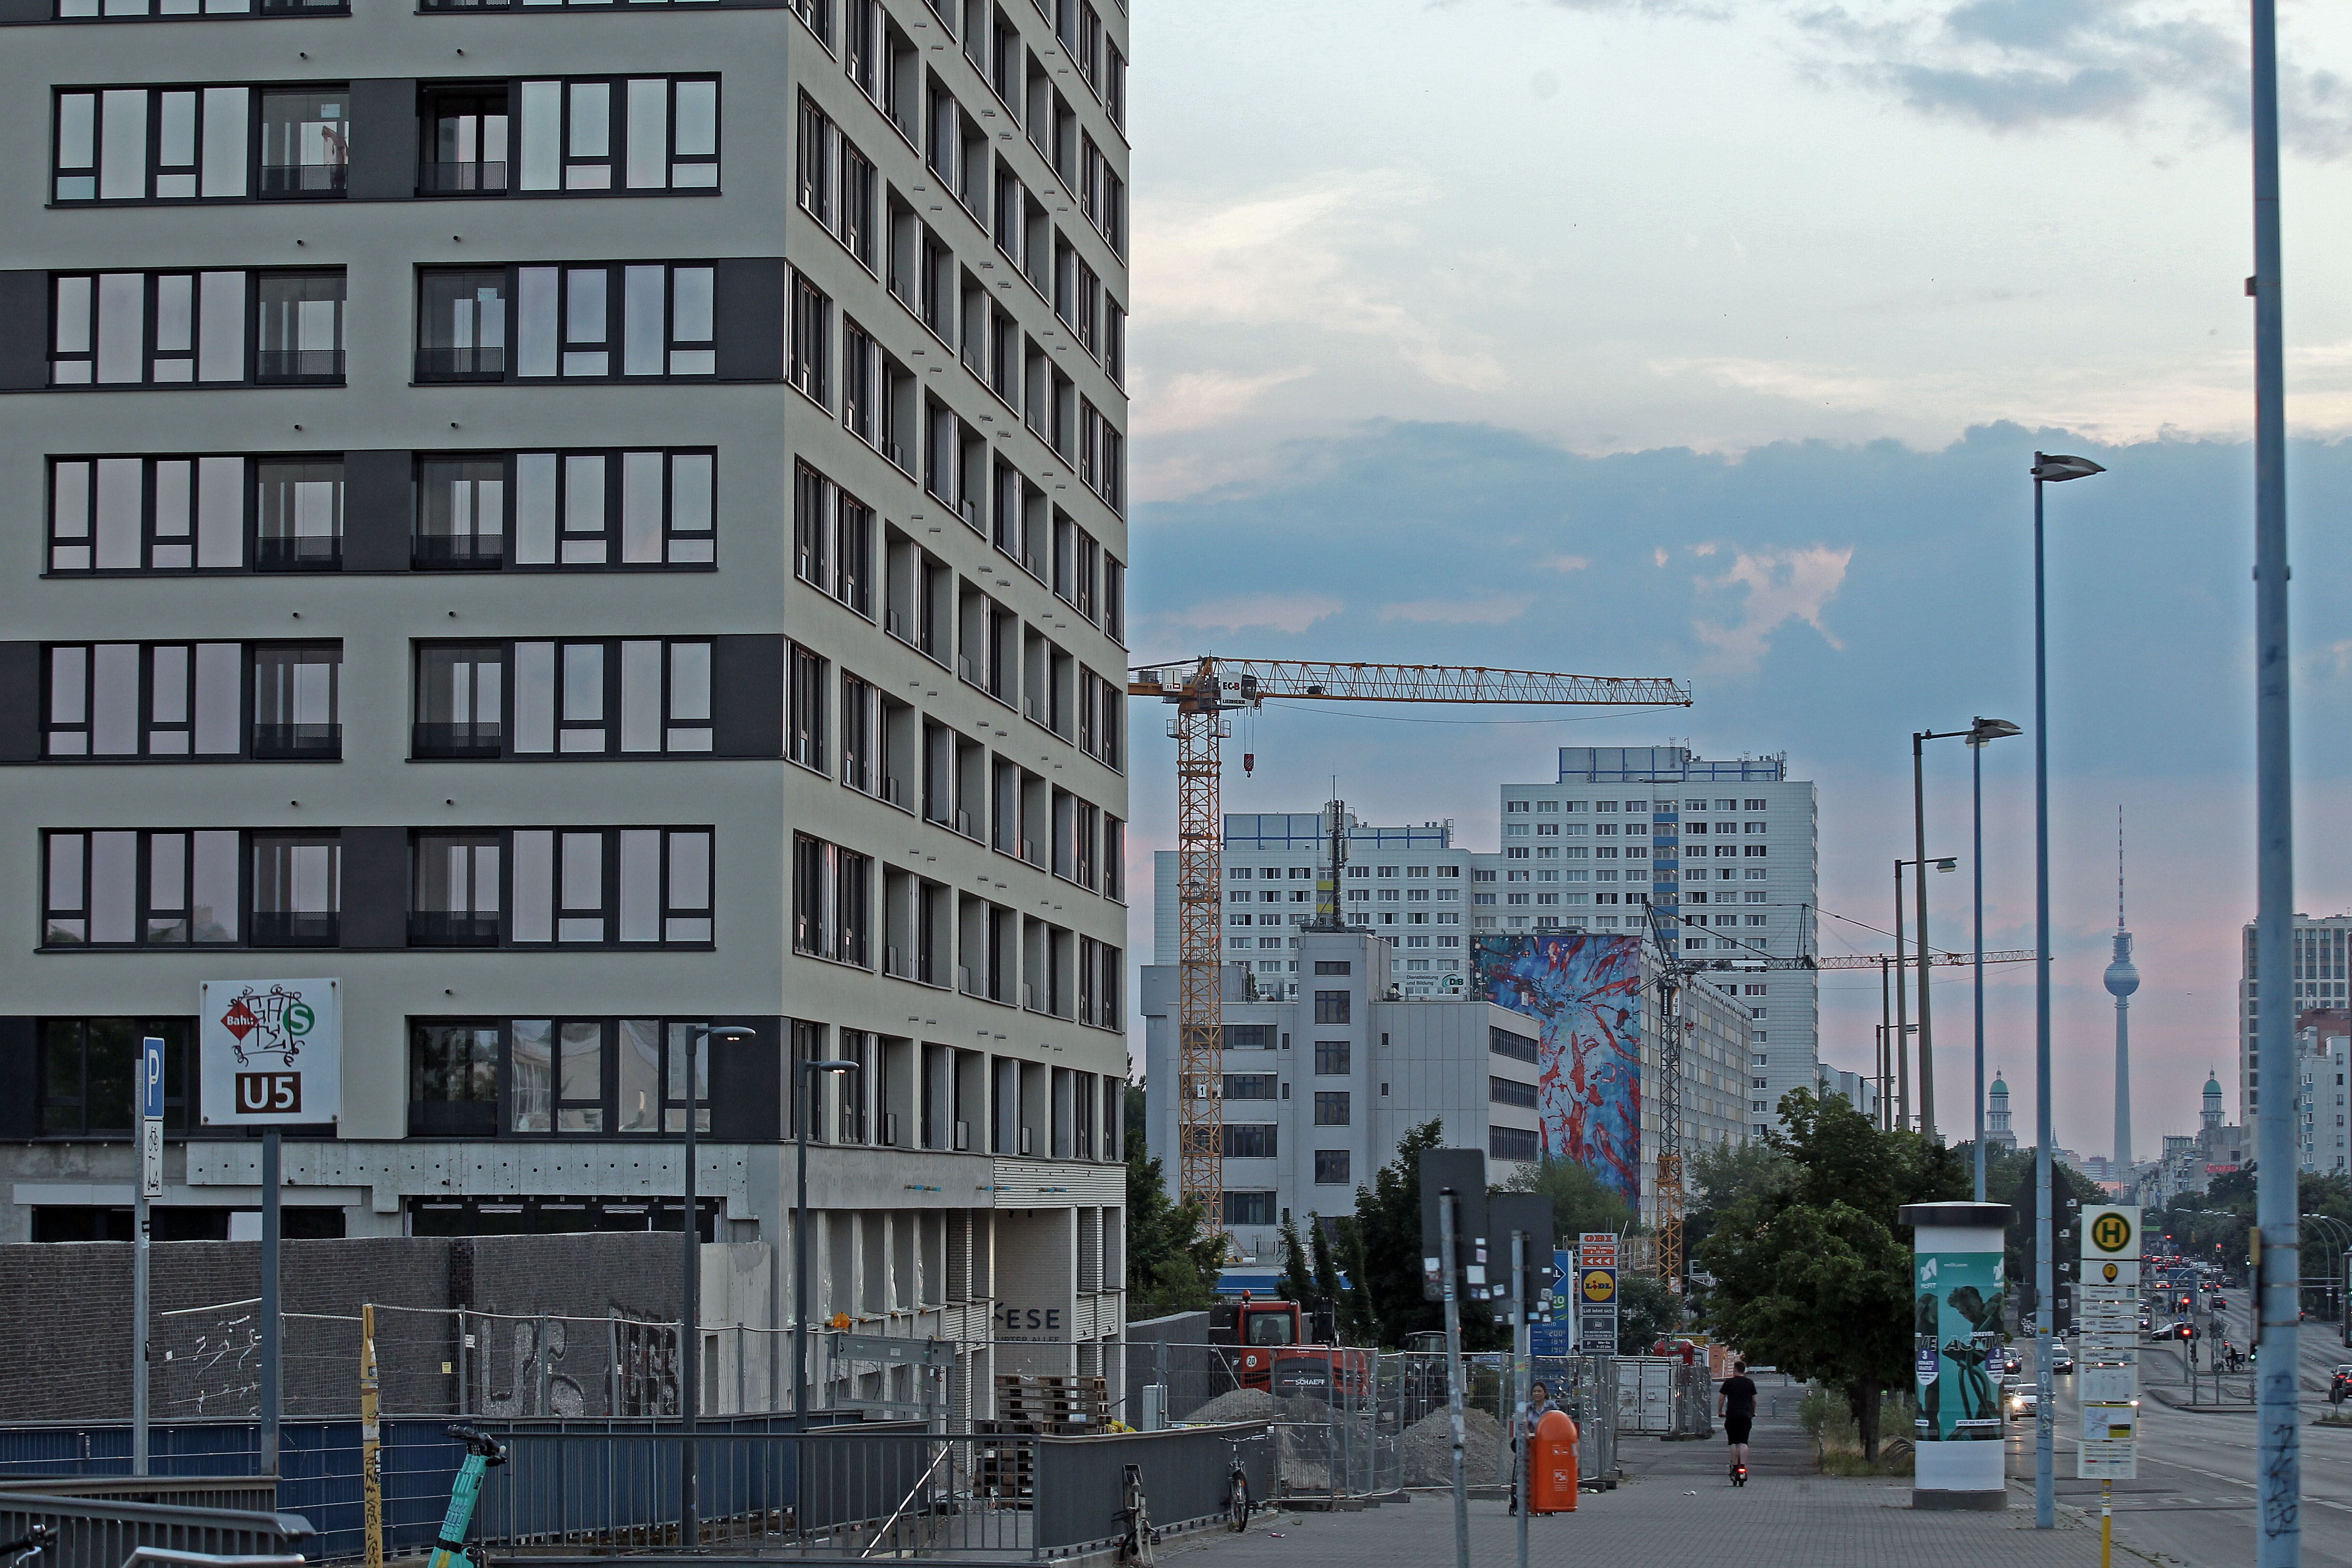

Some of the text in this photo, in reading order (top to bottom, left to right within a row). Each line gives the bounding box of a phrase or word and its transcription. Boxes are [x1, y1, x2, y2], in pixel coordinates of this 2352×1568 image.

[1223, 682, 1240, 690] EC-B
[148, 1049, 159, 1107] P
[244, 1076, 294, 1109] U5
[1200, 1086, 1204, 1095] 1
[2102, 1222, 2120, 1243] H
[1585, 1280, 1612, 1290] LIDL
[1921, 1350, 1928, 1360] 3
[1248, 1357, 1255, 1365] 20
